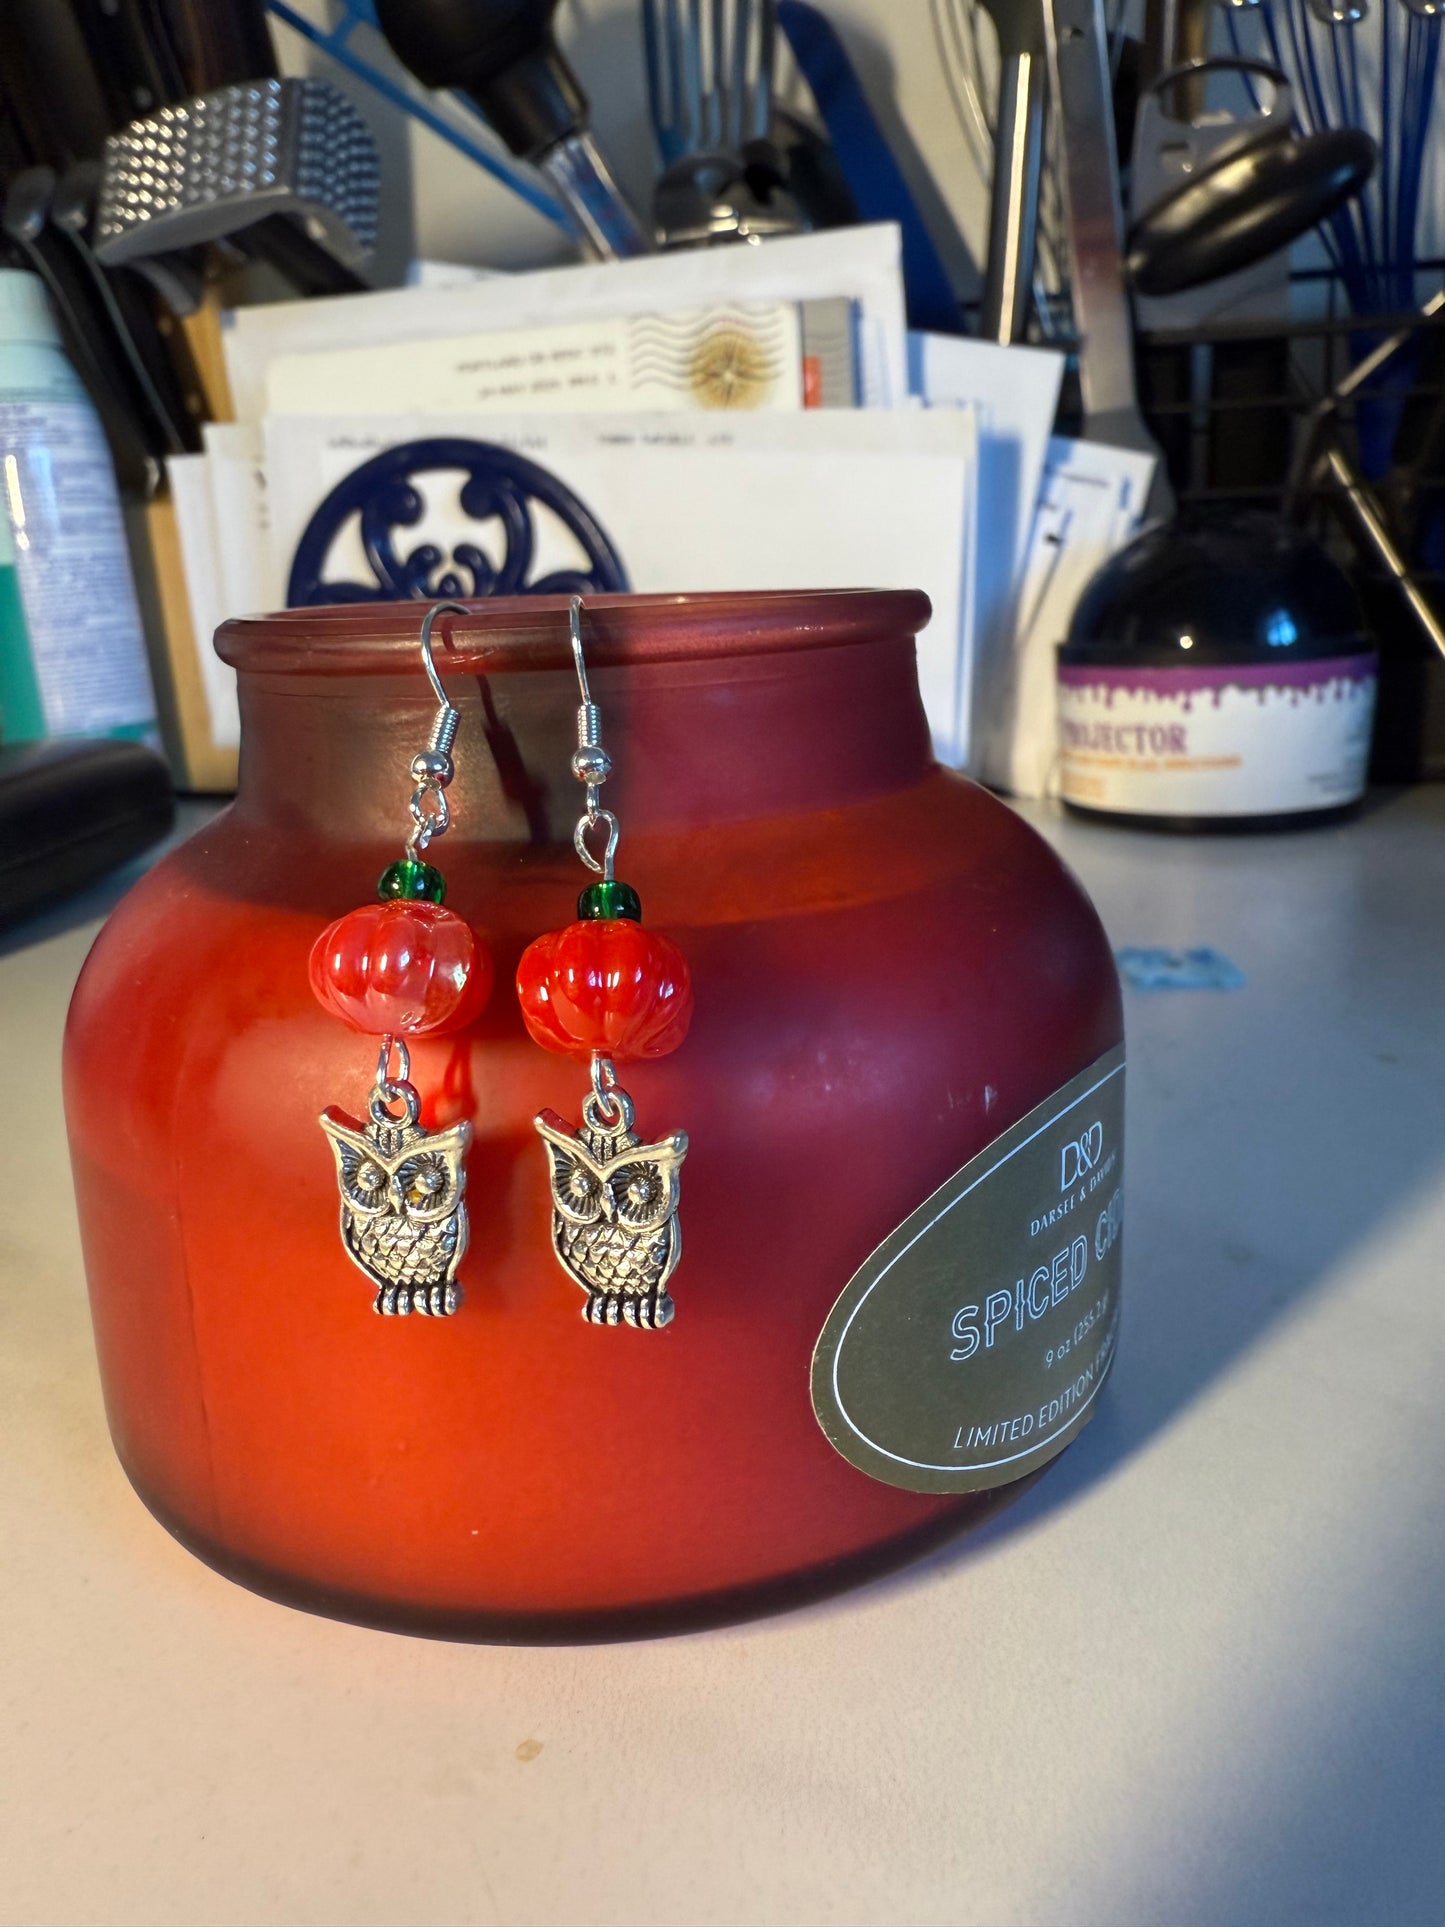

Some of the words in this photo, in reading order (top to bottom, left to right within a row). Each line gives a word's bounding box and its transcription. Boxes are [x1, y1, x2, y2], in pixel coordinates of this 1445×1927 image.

[950, 1234, 1088, 1361] SPICED
[1045, 1349, 1055, 1369] 9
[1057, 1339, 1072, 1360] oz
[953, 1413, 1034, 1449] LIMITED
[1038, 1363, 1094, 1429] EDITION
